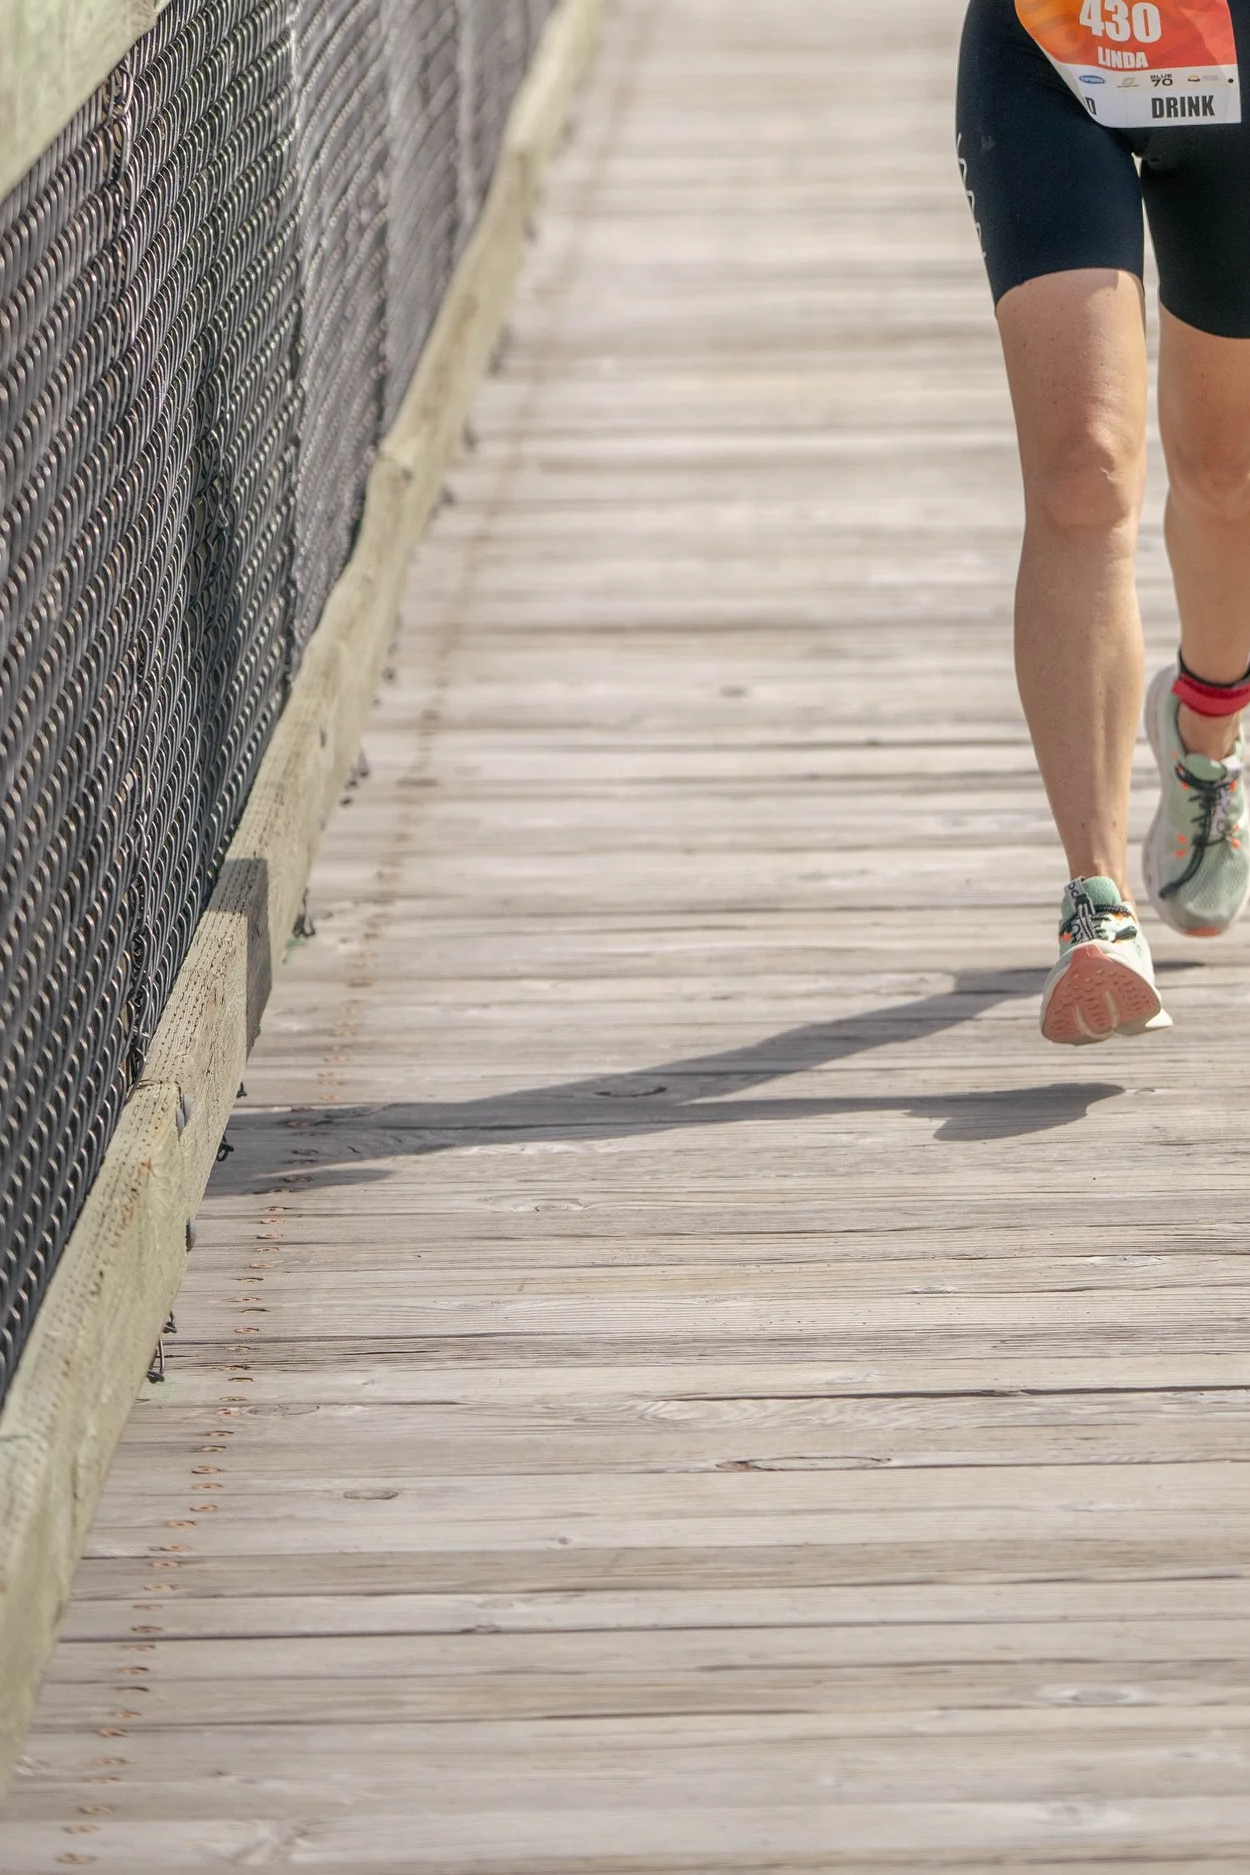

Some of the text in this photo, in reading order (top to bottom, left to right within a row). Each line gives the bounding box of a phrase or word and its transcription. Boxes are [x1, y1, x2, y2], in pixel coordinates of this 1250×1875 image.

[1097, 45, 1149, 69] LINDA
[1151, 78, 1174, 87] 70
[1151, 95, 1216, 119] DRINK
